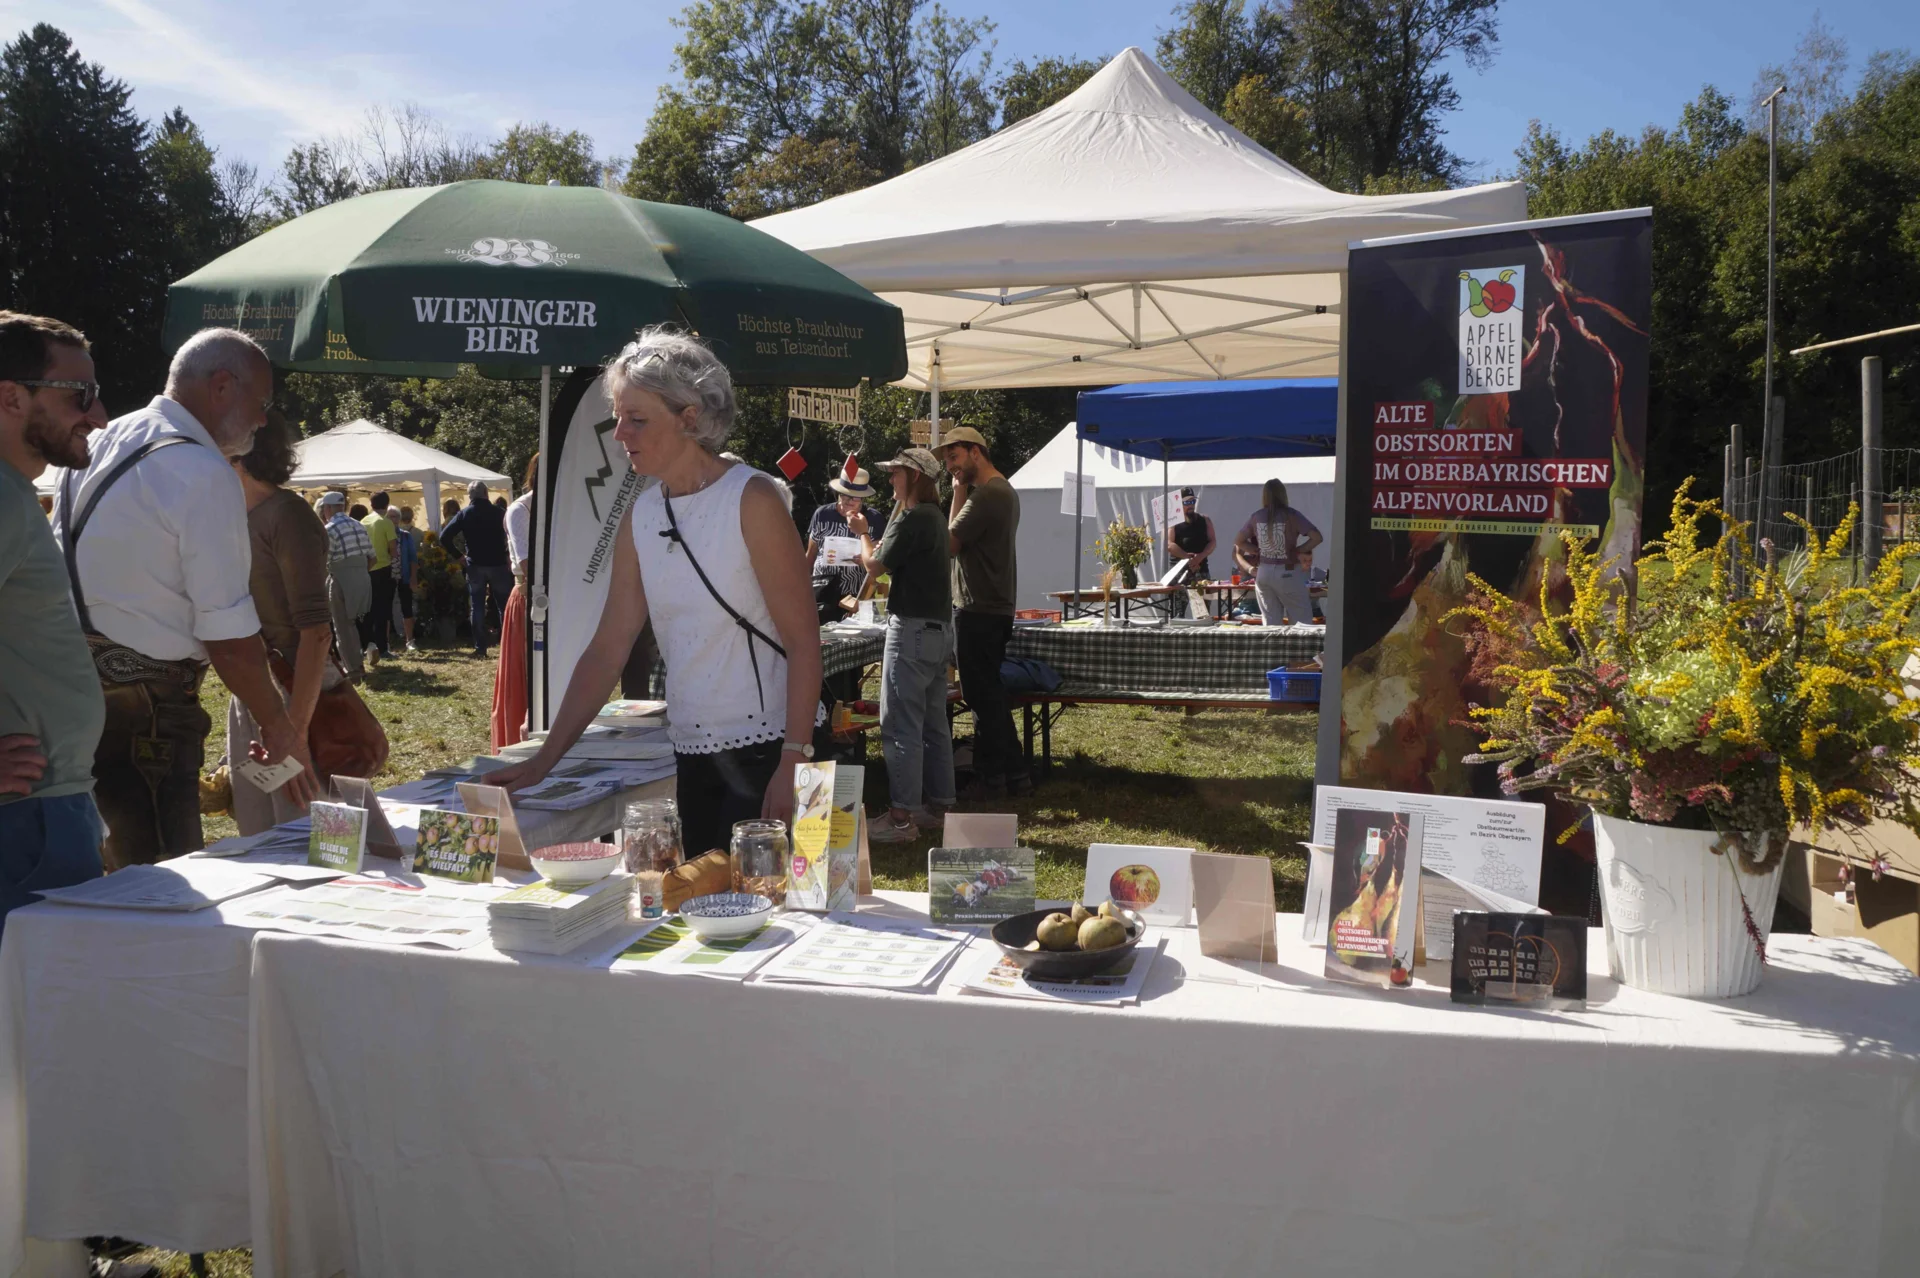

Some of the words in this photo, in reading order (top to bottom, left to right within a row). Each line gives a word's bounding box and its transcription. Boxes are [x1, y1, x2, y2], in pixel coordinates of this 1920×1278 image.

[412, 296, 598, 327] WIENINGER
[737, 313, 793, 334] Höchste
[795, 317, 864, 339] Braukultur
[1467, 322, 1516, 345] APFEL
[464, 326, 540, 354] BIER
[755, 340, 778, 355] aus
[780, 338, 852, 358] Teisendorf.
[1466, 344, 1515, 367] BIRNE
[1465, 366, 1515, 388] BERGE
[1375, 404, 1427, 423] ALTE
[1375, 432, 1514, 452] OBSTSORTEN
[1374, 463, 1399, 481] IM
[1405, 462, 1609, 483] OBERBAYRISCHEN
[1373, 492, 1548, 513] ALPENVORLAND
[1506, 525, 1544, 534] ZUKUNFT
[1486, 810, 1516, 819] Ausbildung
[320, 841, 327, 851] ES
[1498, 833, 1532, 842] Oberbayern
[430, 849, 439, 859] ES
[439, 850, 458, 862] LEBE
[458, 853, 471, 864] DIE
